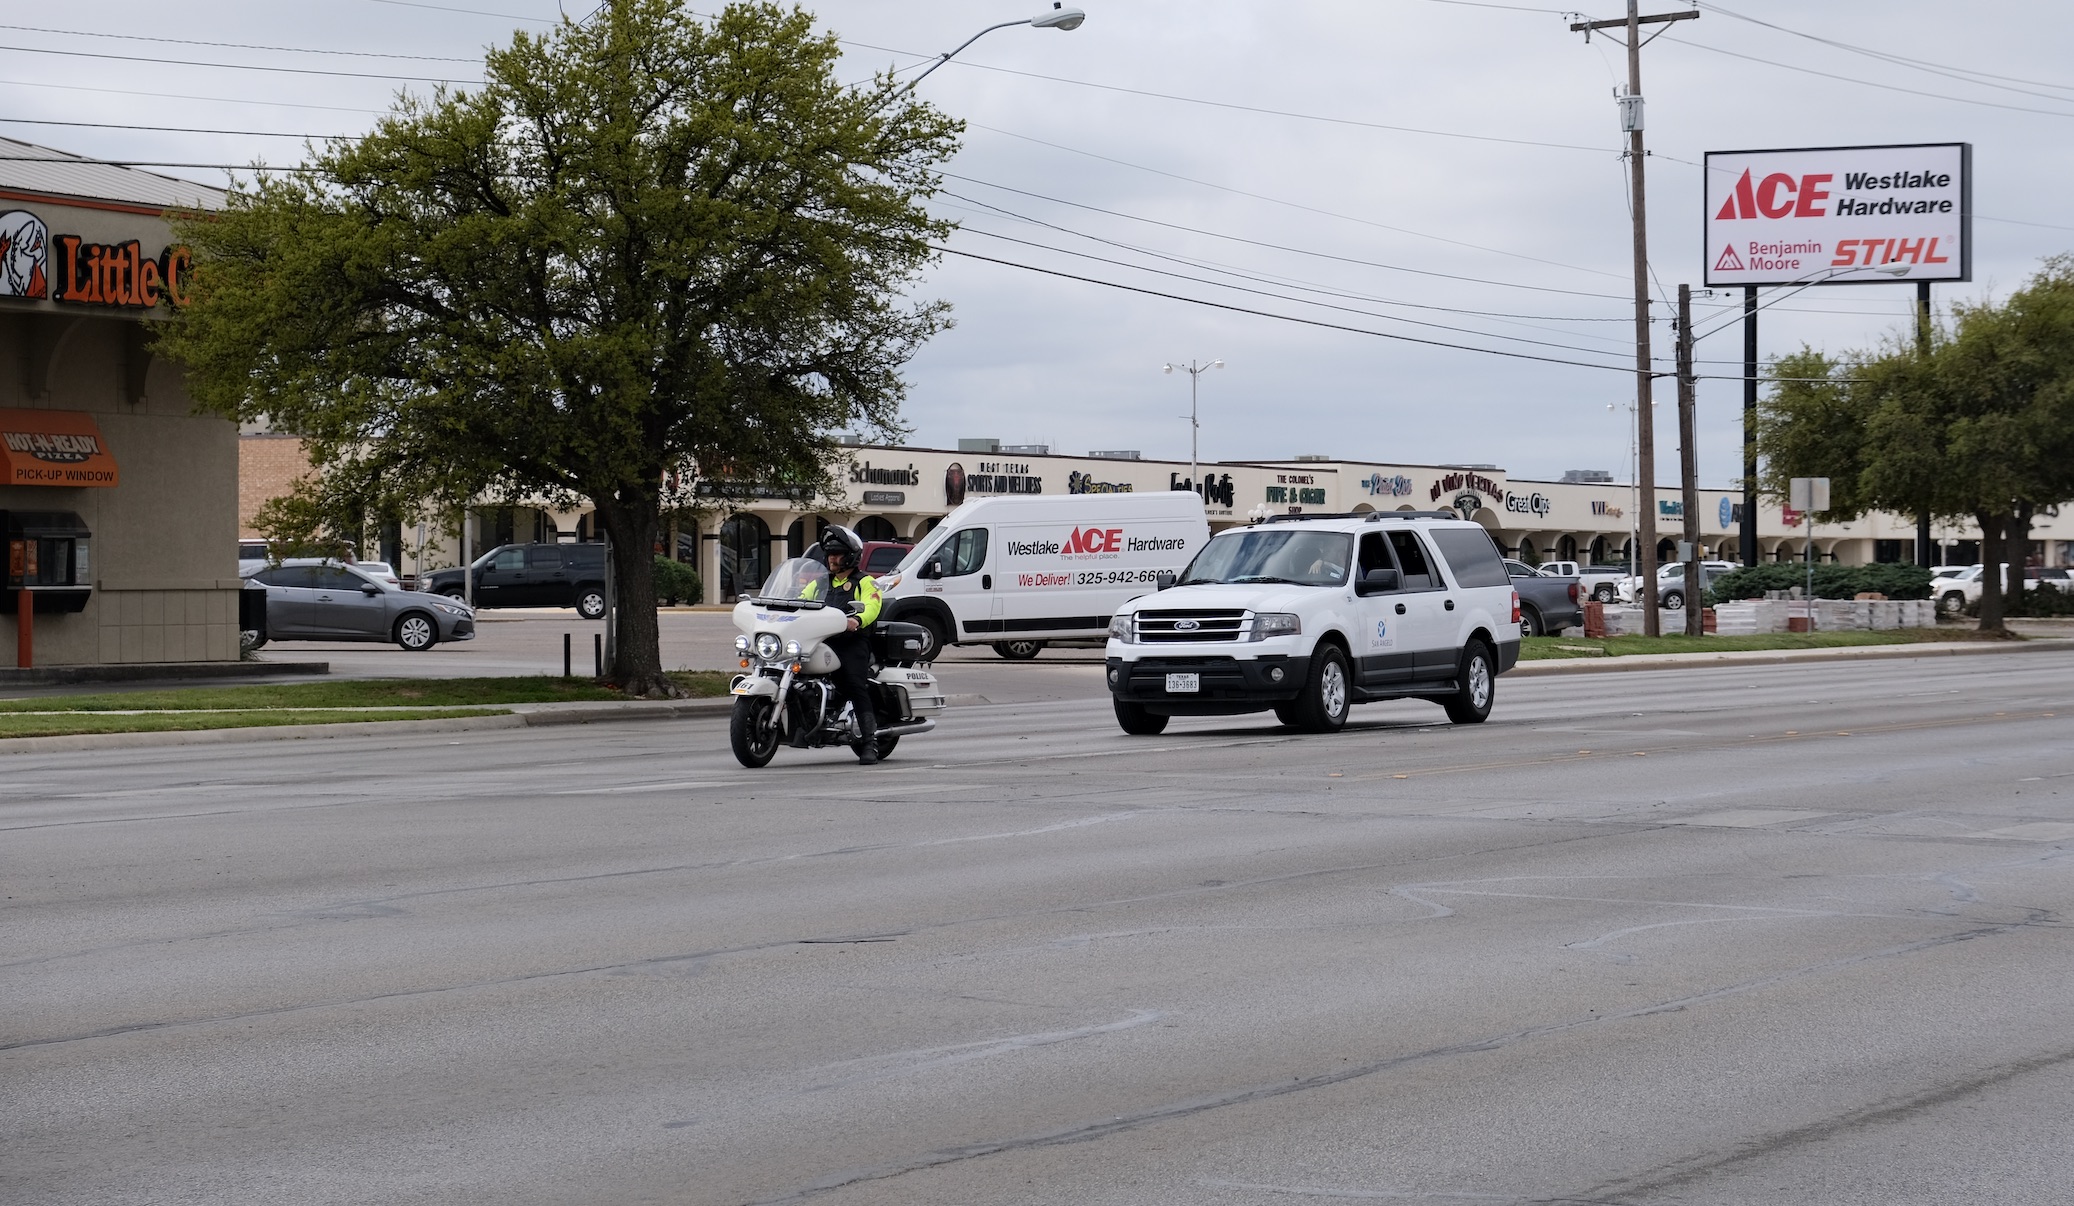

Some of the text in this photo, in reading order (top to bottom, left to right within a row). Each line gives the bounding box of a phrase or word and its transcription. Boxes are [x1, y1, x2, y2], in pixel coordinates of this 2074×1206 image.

[1845, 170, 1950, 190] Westlake
[1715, 166, 1833, 220] ACE
[1836, 197, 1952, 216] Hardware
[1749, 239, 1822, 257] Benjamin
[1831, 237, 1948, 266] STIHL
[58, 236, 160, 307] Little
[1750, 257, 1800, 271] Moore
[2, 432, 100, 454] HOT-N-READY
[36, 452, 84, 460] PIZZA
[16, 469, 114, 482] PICK-UP WINDOW
[849, 461, 919, 486] Schumann's
[978, 462, 1029, 474] WEST TEXAS
[967, 474, 1042, 494] SPORTS AND WELLNESS
[1465, 472, 1503, 503] VERITAS
[1289, 487, 1298, 503] &
[1506, 491, 1529, 513] Great
[1530, 492, 1550, 519] Clips
[1007, 525, 1185, 556] Westlake ACE Hardware
[1074, 553, 1098, 561] helpful
[1018, 574, 1033, 587] We
[1035, 572, 1071, 586] Deliver!
[906, 672, 929, 680] POLICE
